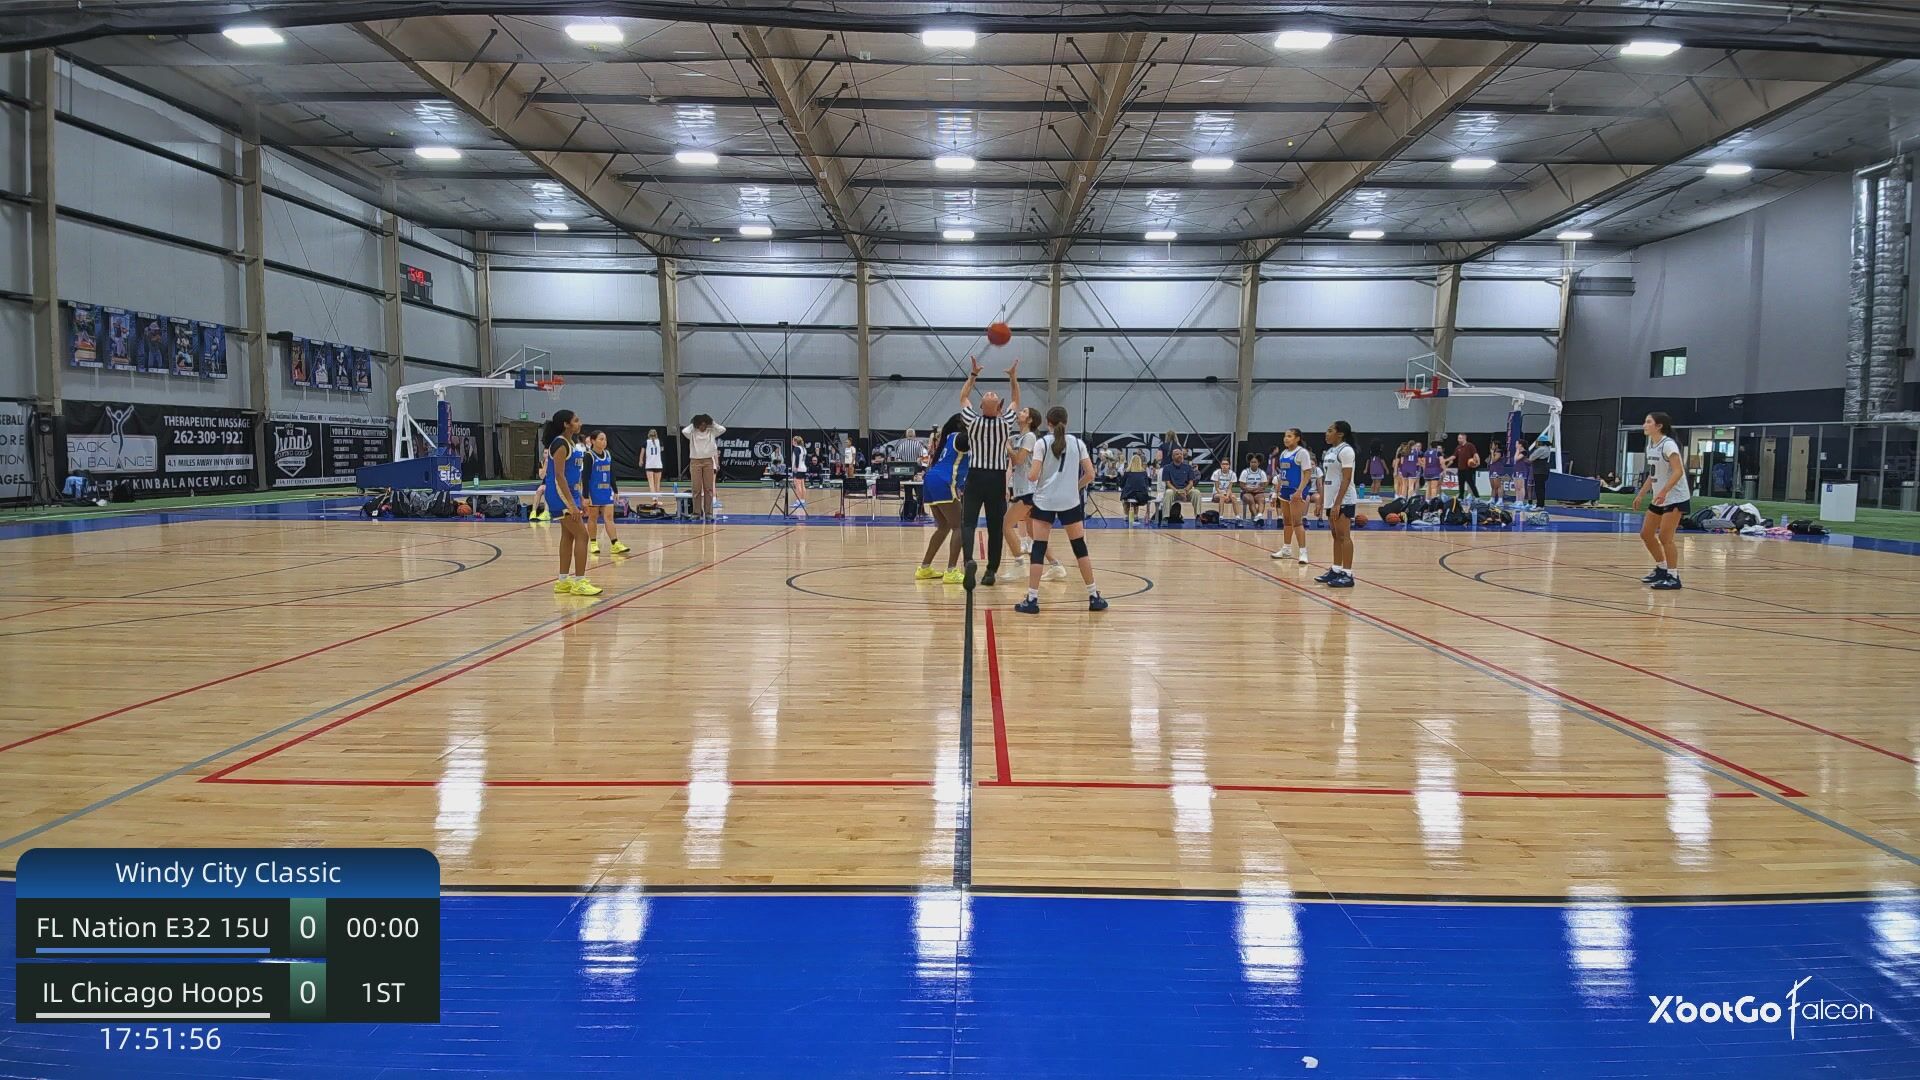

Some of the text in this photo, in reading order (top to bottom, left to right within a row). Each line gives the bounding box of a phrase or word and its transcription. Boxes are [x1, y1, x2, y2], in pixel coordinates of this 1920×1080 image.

[0, 414, 24, 425] EBALL
[163, 415, 251, 428] THERAPEUTIC MASSAGE
[452, 424, 471, 436] Vision
[67, 441, 108, 453] BACK
[651, 447, 657, 455] 11
[723, 449, 752, 458] Bank
[87, 456, 153, 468] BALANCE
[197, 458, 213, 467] AWAY
[214, 458, 220, 466] IN
[221, 457, 234, 466] NEW
